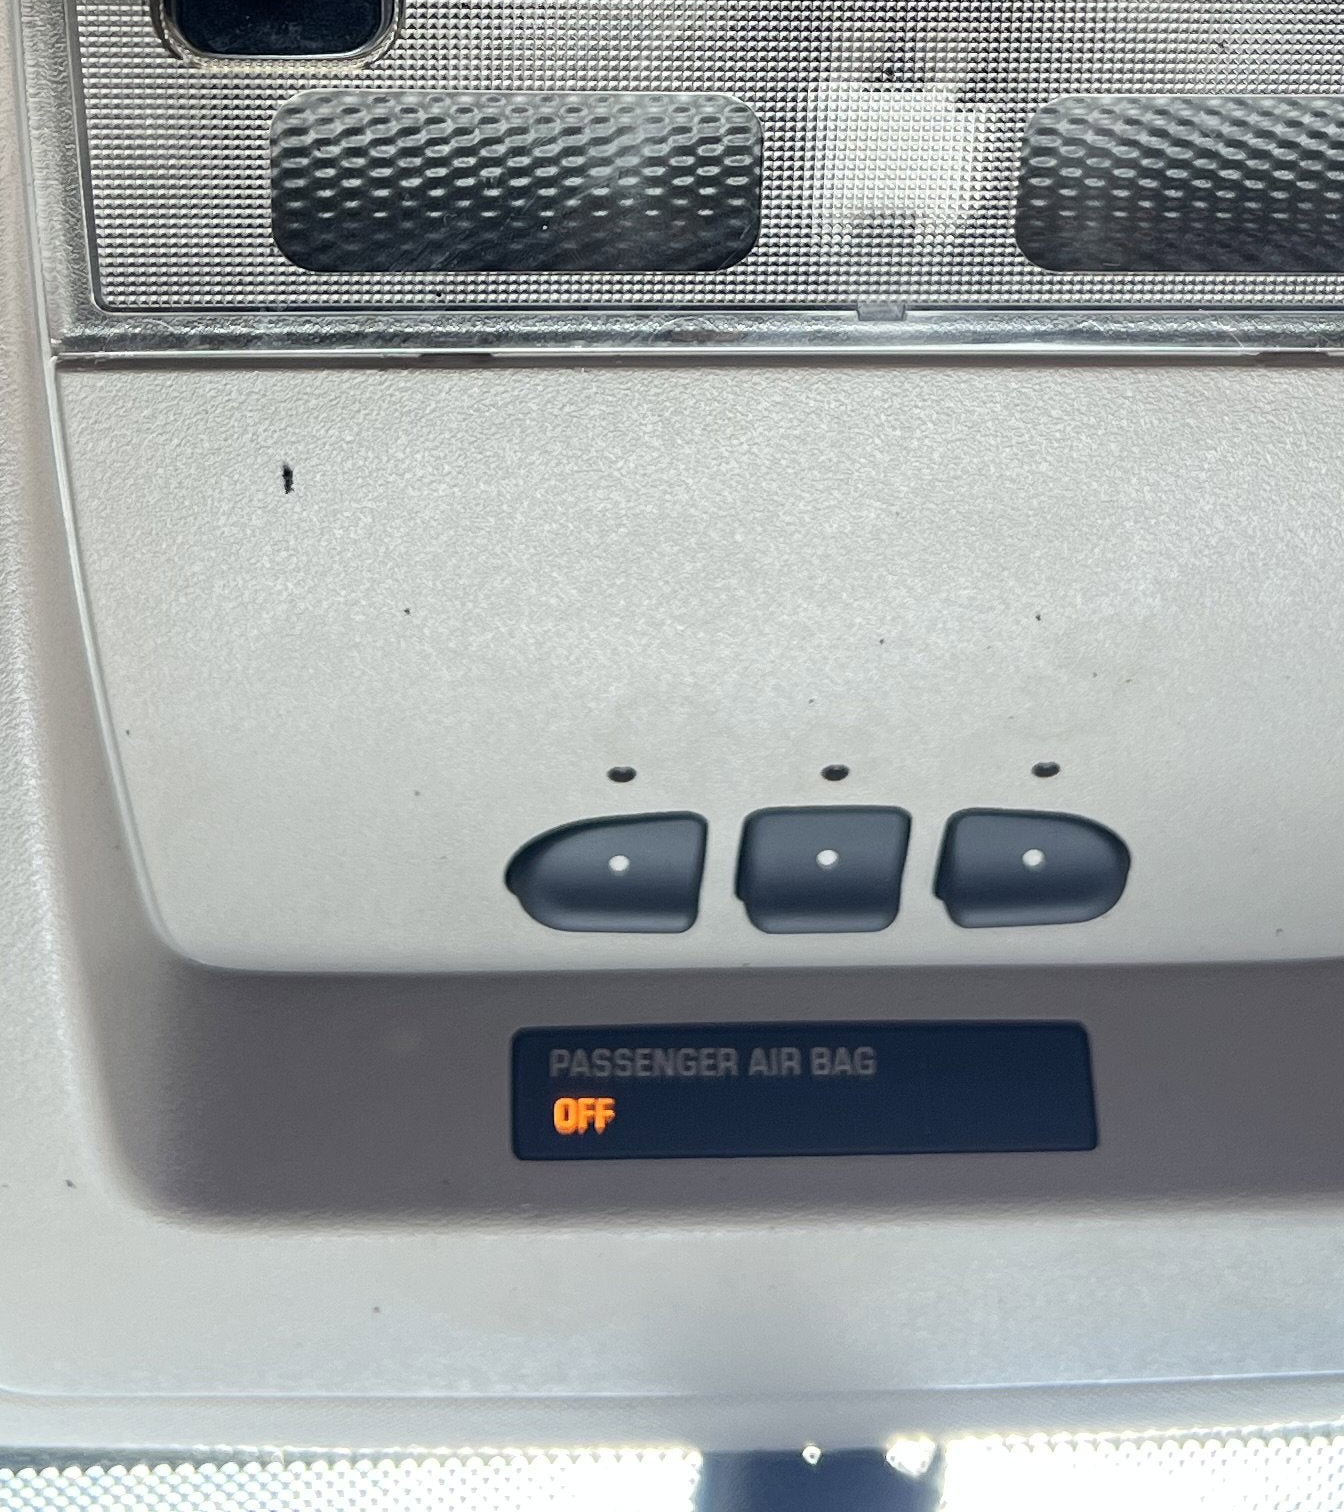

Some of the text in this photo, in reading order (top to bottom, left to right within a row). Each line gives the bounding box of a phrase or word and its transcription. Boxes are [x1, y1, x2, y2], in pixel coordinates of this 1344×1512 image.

[549, 1047, 877, 1078] PASSENGER AIR BAG
[553, 1096, 616, 1135] OFF
